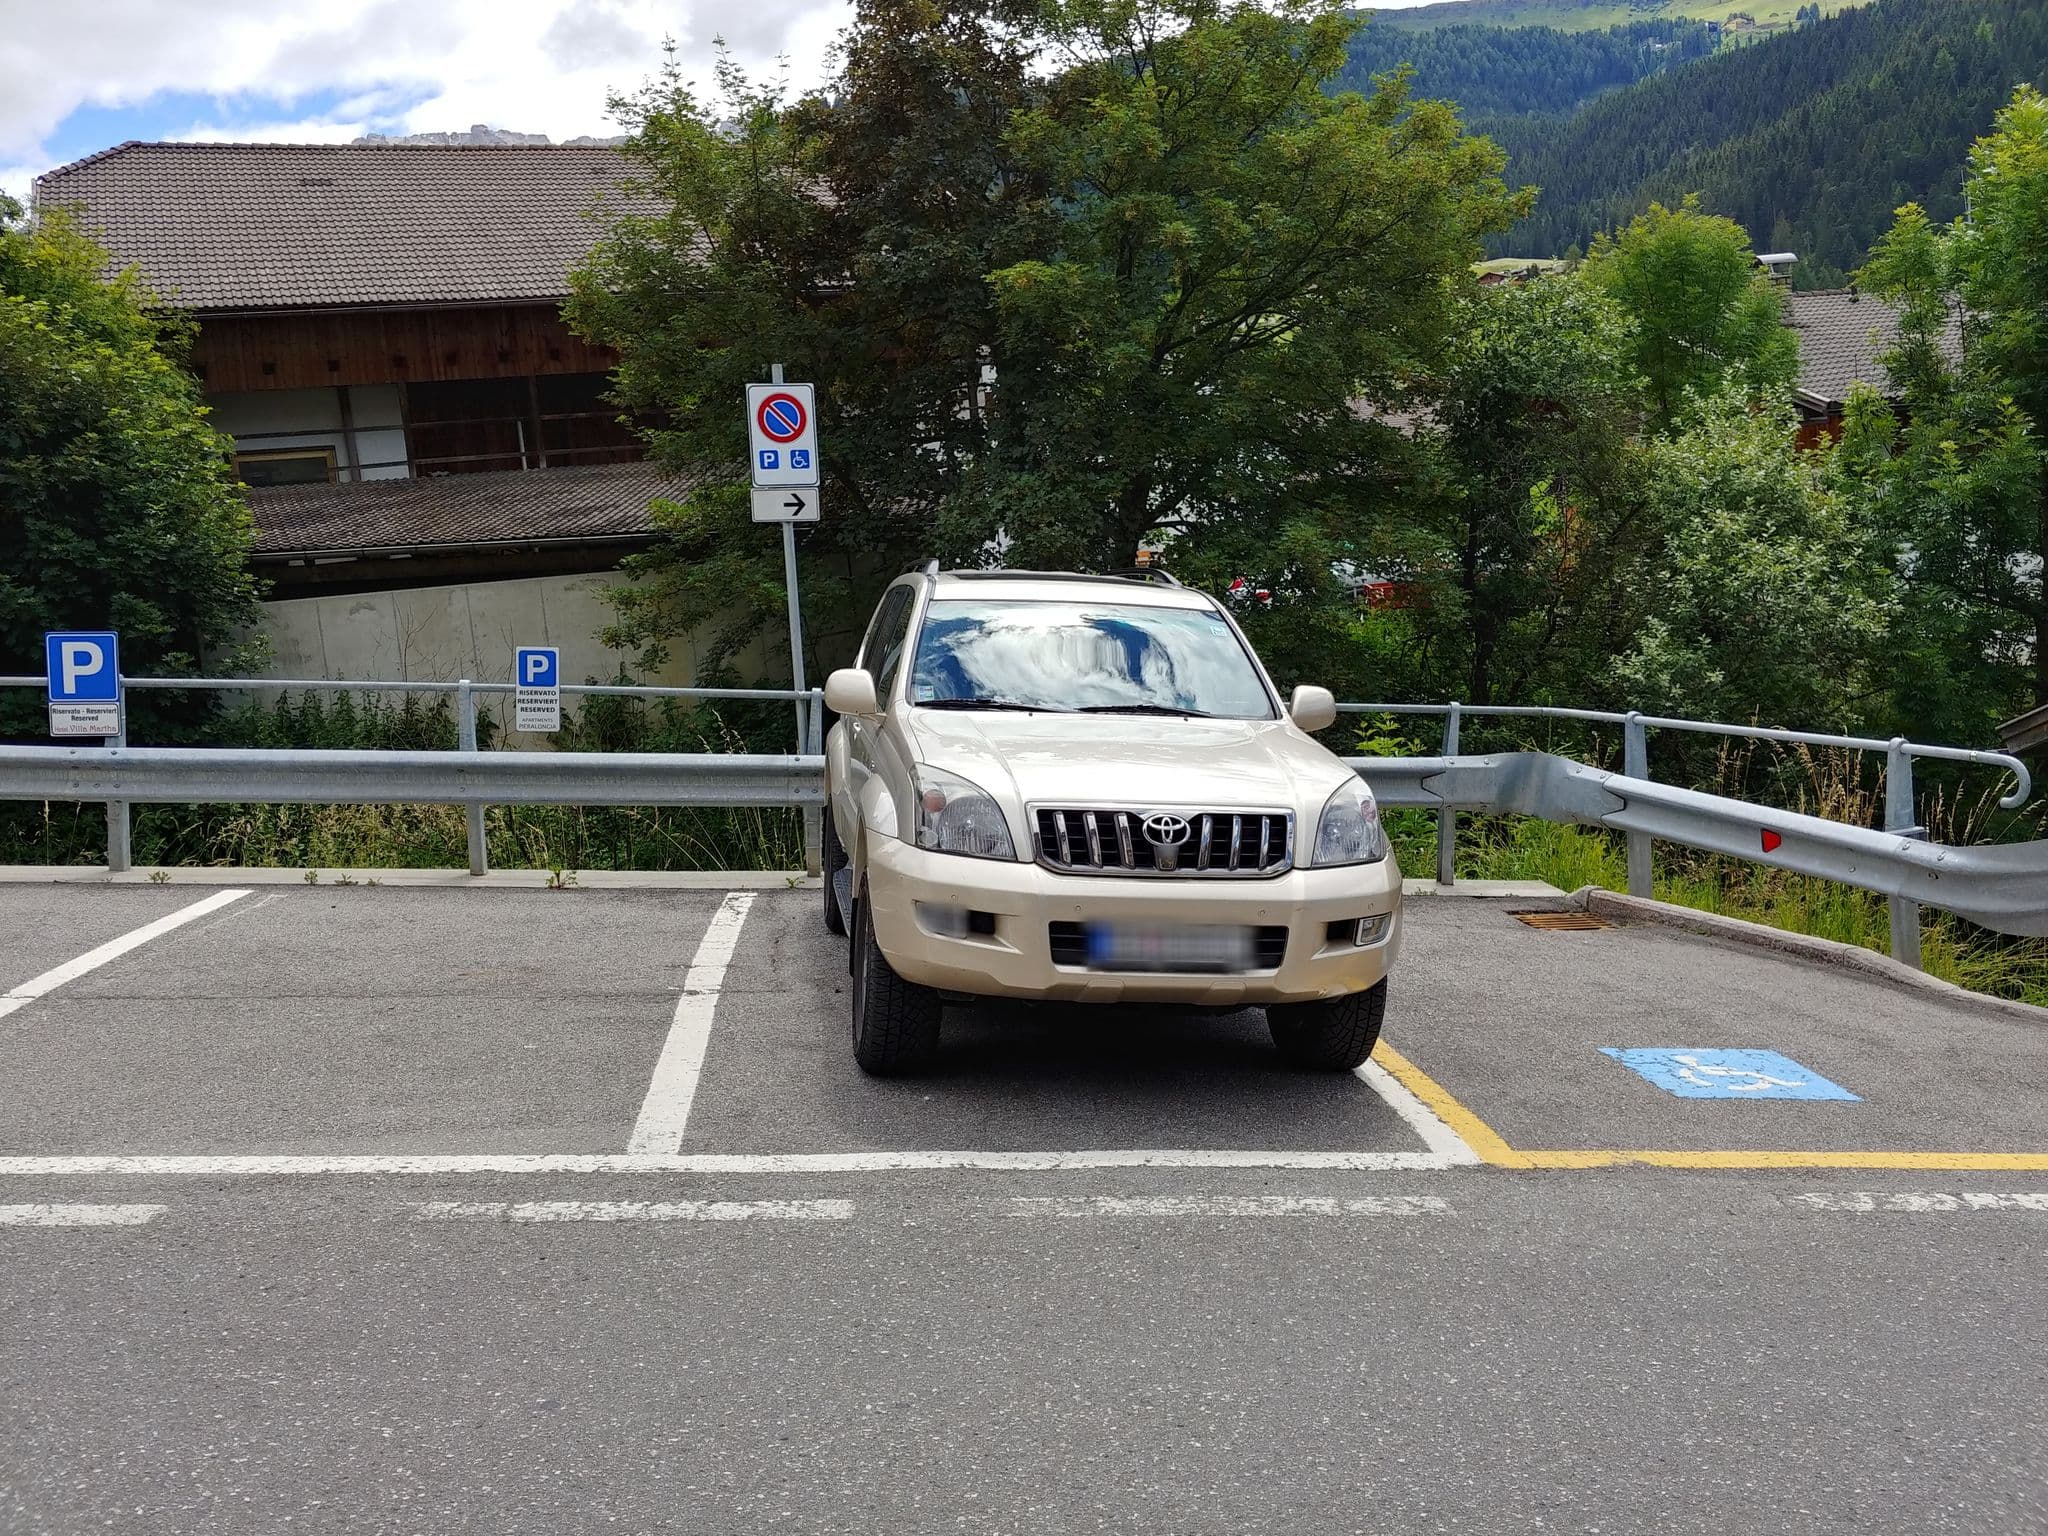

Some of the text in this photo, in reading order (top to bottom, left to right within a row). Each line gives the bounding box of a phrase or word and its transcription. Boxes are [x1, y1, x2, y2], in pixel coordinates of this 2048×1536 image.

[763, 452, 775, 467] P
[61, 641, 104, 694] P
[526, 654, 549, 683] P
[70, 725, 88, 733] Villa
[89, 725, 117, 733] Martha
